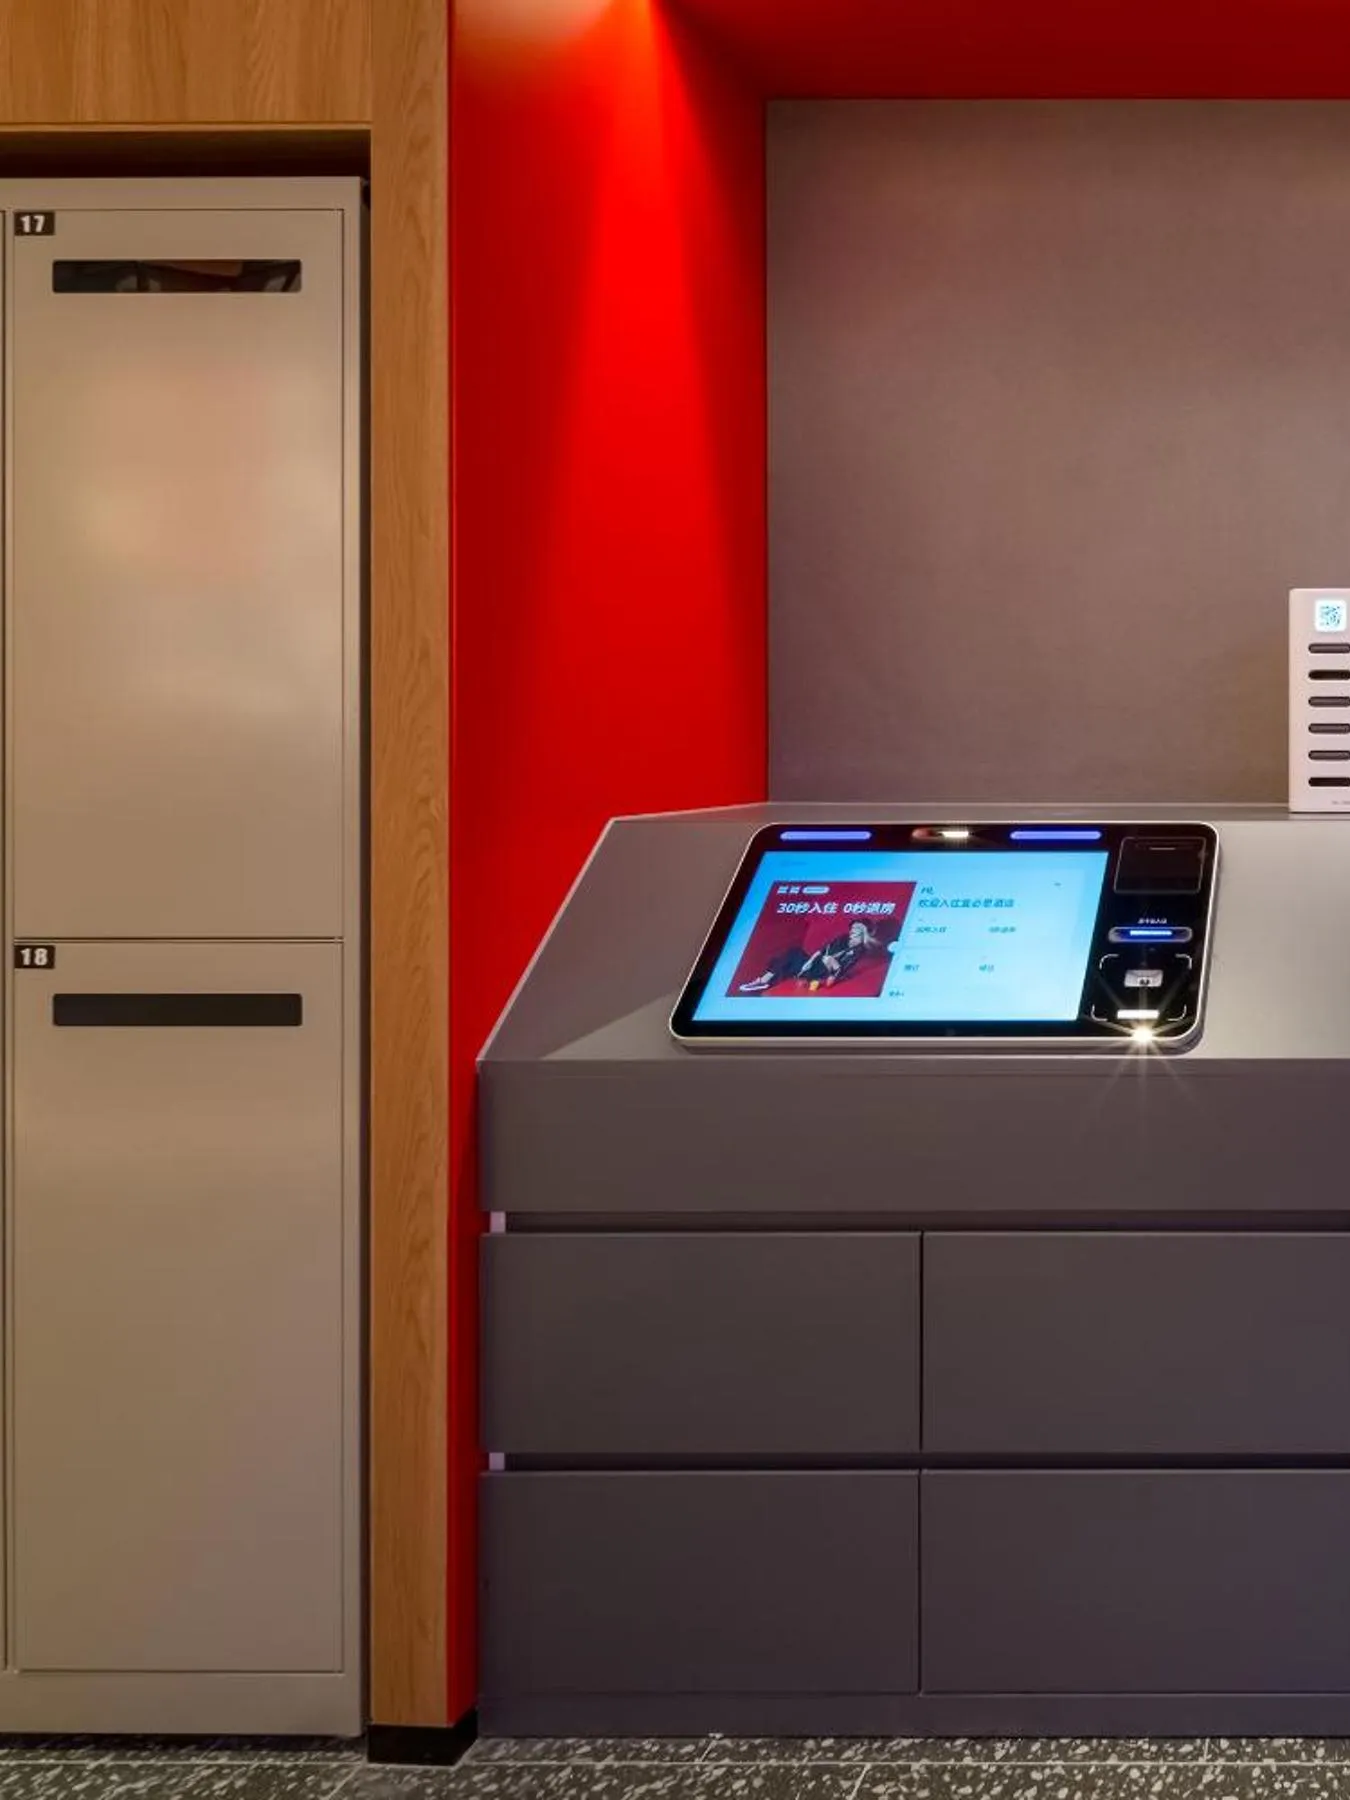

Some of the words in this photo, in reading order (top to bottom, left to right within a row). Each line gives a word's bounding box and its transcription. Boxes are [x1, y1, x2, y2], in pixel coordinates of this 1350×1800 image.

[21, 215, 45, 232] 17
[777, 902, 838, 914] 30秒入住
[843, 901, 896, 915] 0秒退房
[20, 948, 48, 966] 18
